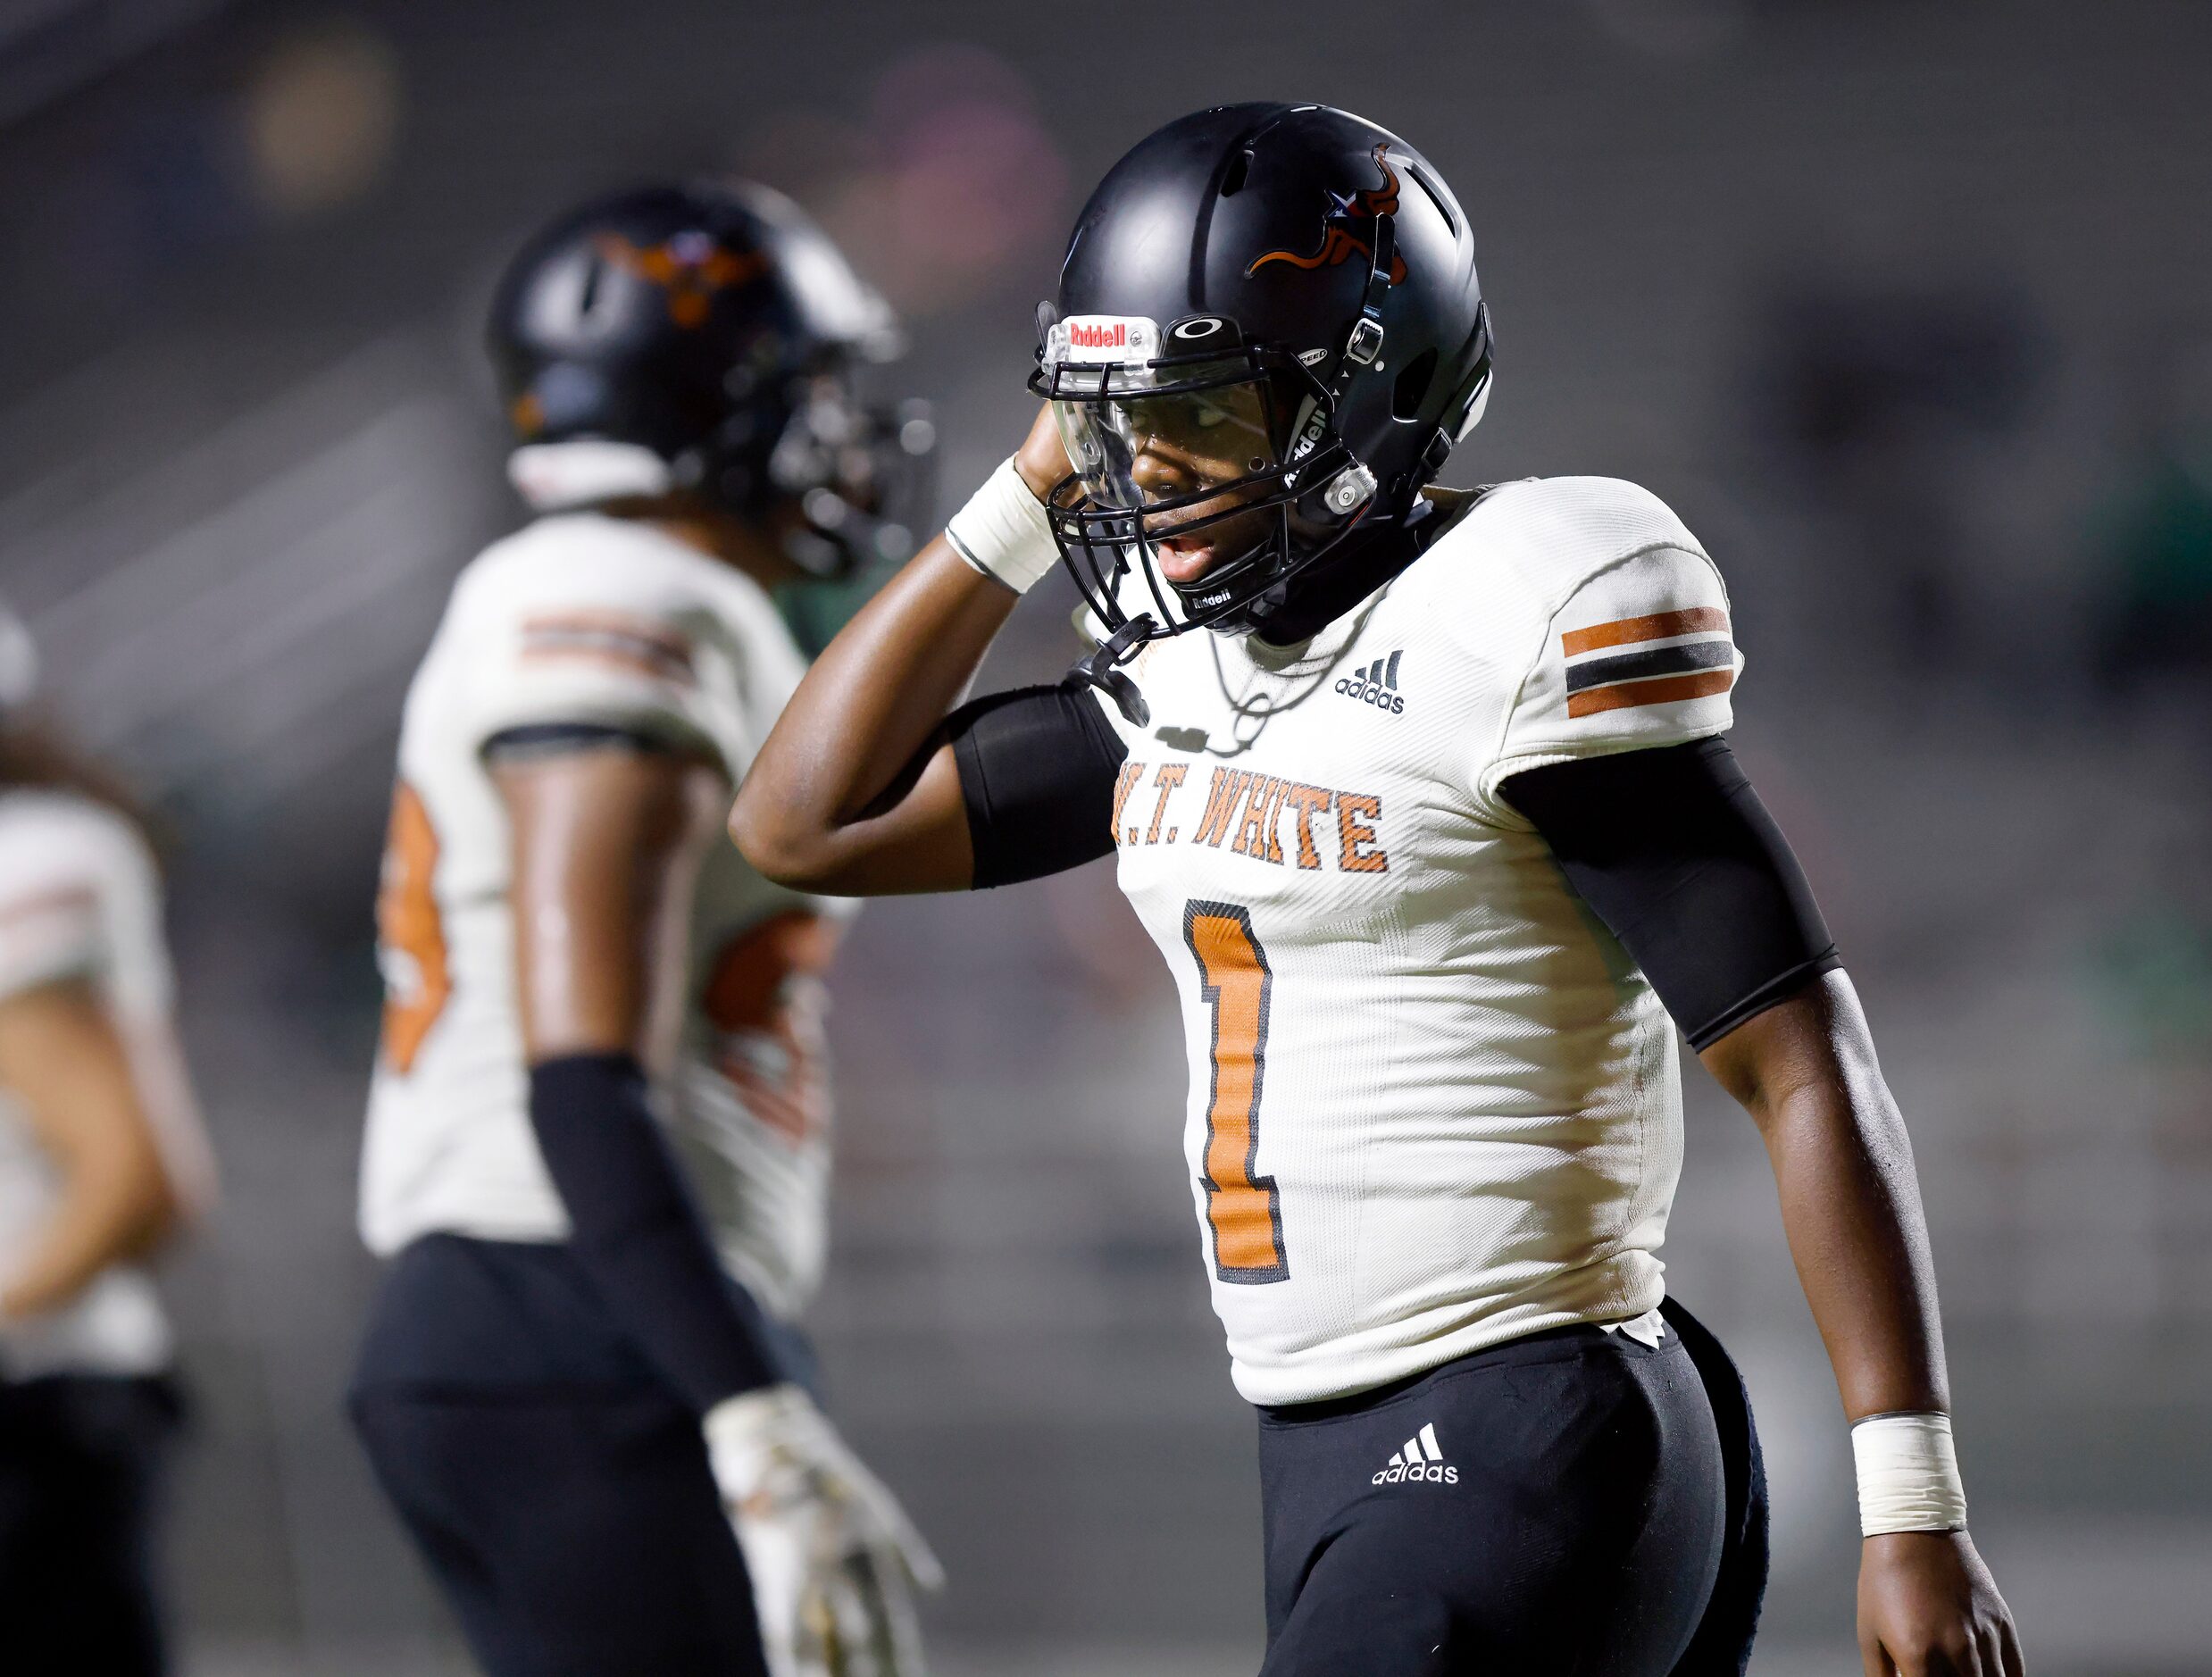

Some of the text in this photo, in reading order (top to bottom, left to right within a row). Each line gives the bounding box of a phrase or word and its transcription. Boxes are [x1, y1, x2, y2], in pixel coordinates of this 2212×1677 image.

[1071, 322, 1125, 347] Riddell
[1300, 349, 1327, 362] PEED
[1191, 588, 1231, 609] Riddell
[1334, 678, 1405, 714] adidas
[1191, 765, 1390, 873] WHITE
[1183, 898, 1290, 1284] 1
[1372, 1460, 1459, 1485] adidas
